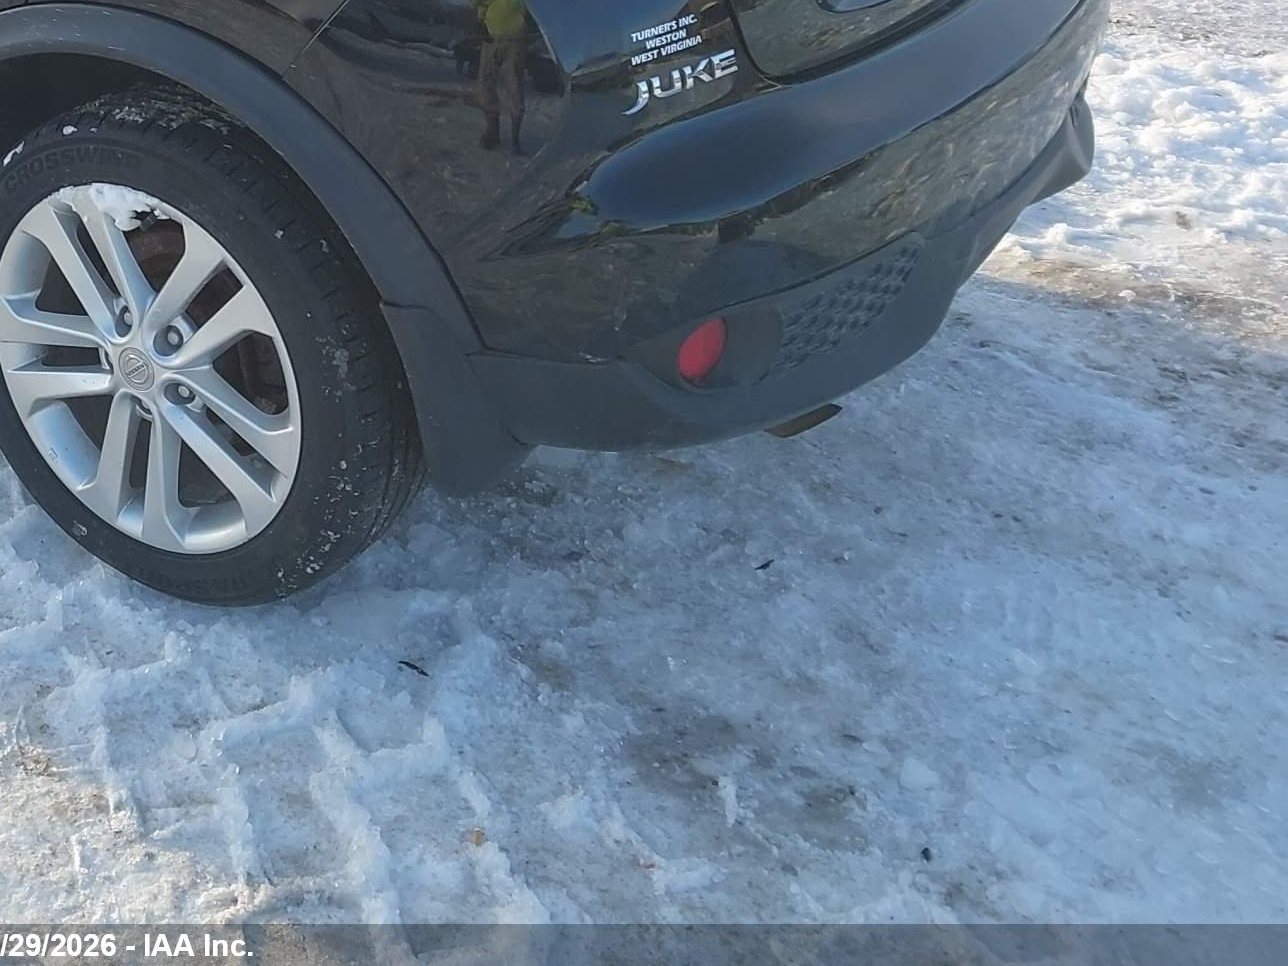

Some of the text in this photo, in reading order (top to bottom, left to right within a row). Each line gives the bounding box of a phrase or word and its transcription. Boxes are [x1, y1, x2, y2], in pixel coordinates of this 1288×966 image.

[631, 20, 678, 43] TURNER'S
[645, 28, 687, 50] WESTON
[631, 34, 703, 66] WEST VIRGINIA
[621, 49, 739, 115] JUKE
